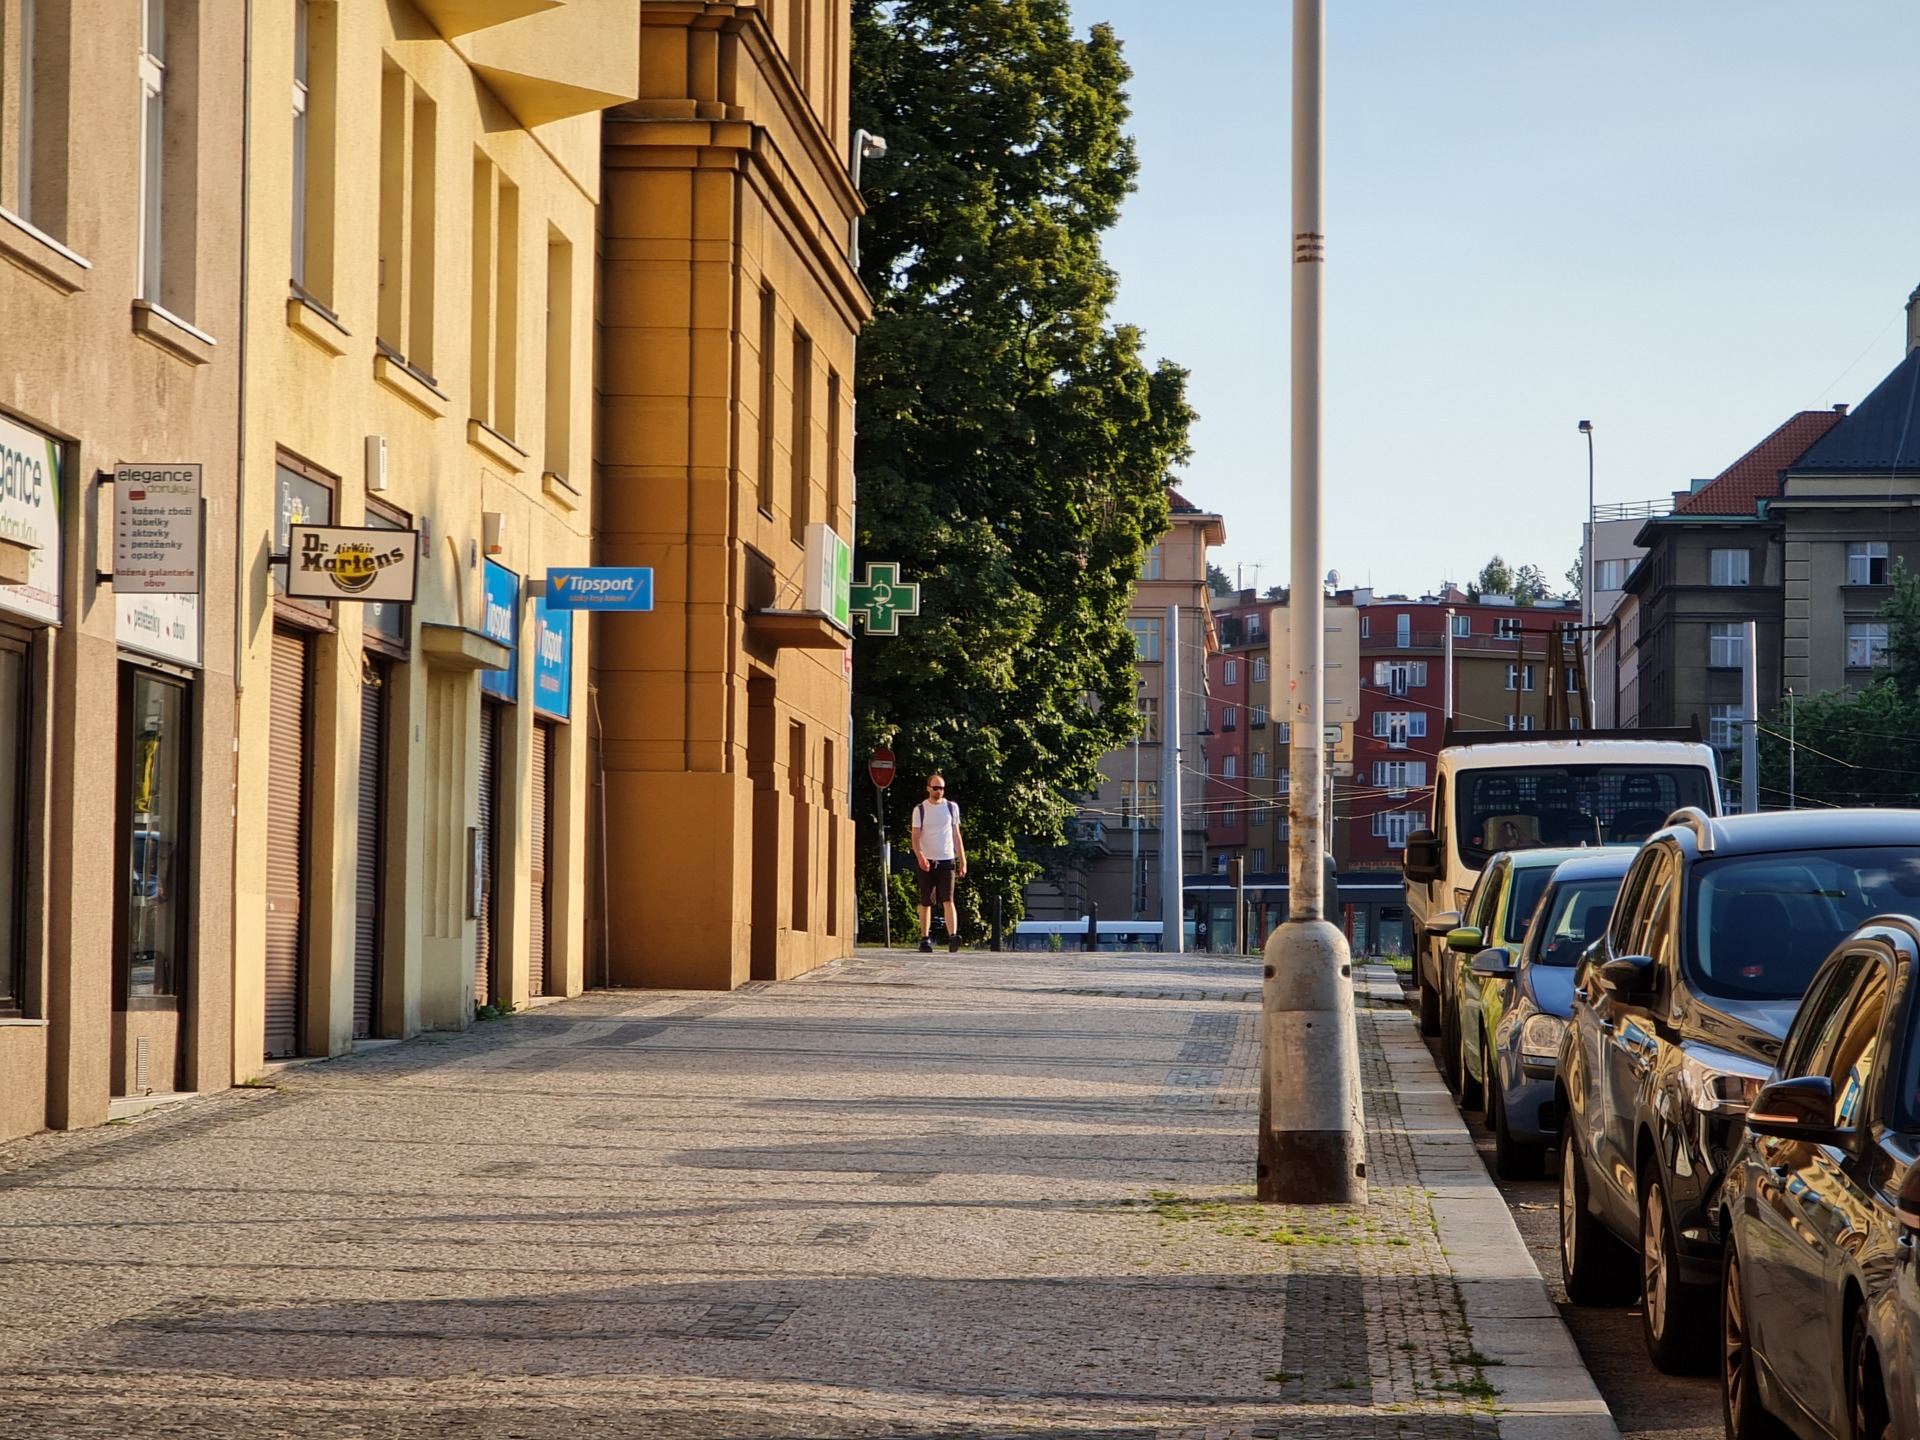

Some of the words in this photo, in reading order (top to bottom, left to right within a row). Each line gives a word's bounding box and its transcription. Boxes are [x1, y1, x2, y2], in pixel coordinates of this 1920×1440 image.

[118, 469, 193, 483] elegance
[132, 506, 166, 515] kožené
[168, 506, 192, 515] zboží
[132, 518, 169, 528] kabelky
[131, 529, 170, 539] aktovky
[131, 540, 183, 550] peněženky
[302, 533, 329, 552] Dr.
[333, 542, 375, 555] AirWair
[131, 551, 165, 561] opasky
[300, 547, 405, 573] Martens
[148, 568, 194, 578] galanterie
[569, 576, 634, 593] Tipsport
